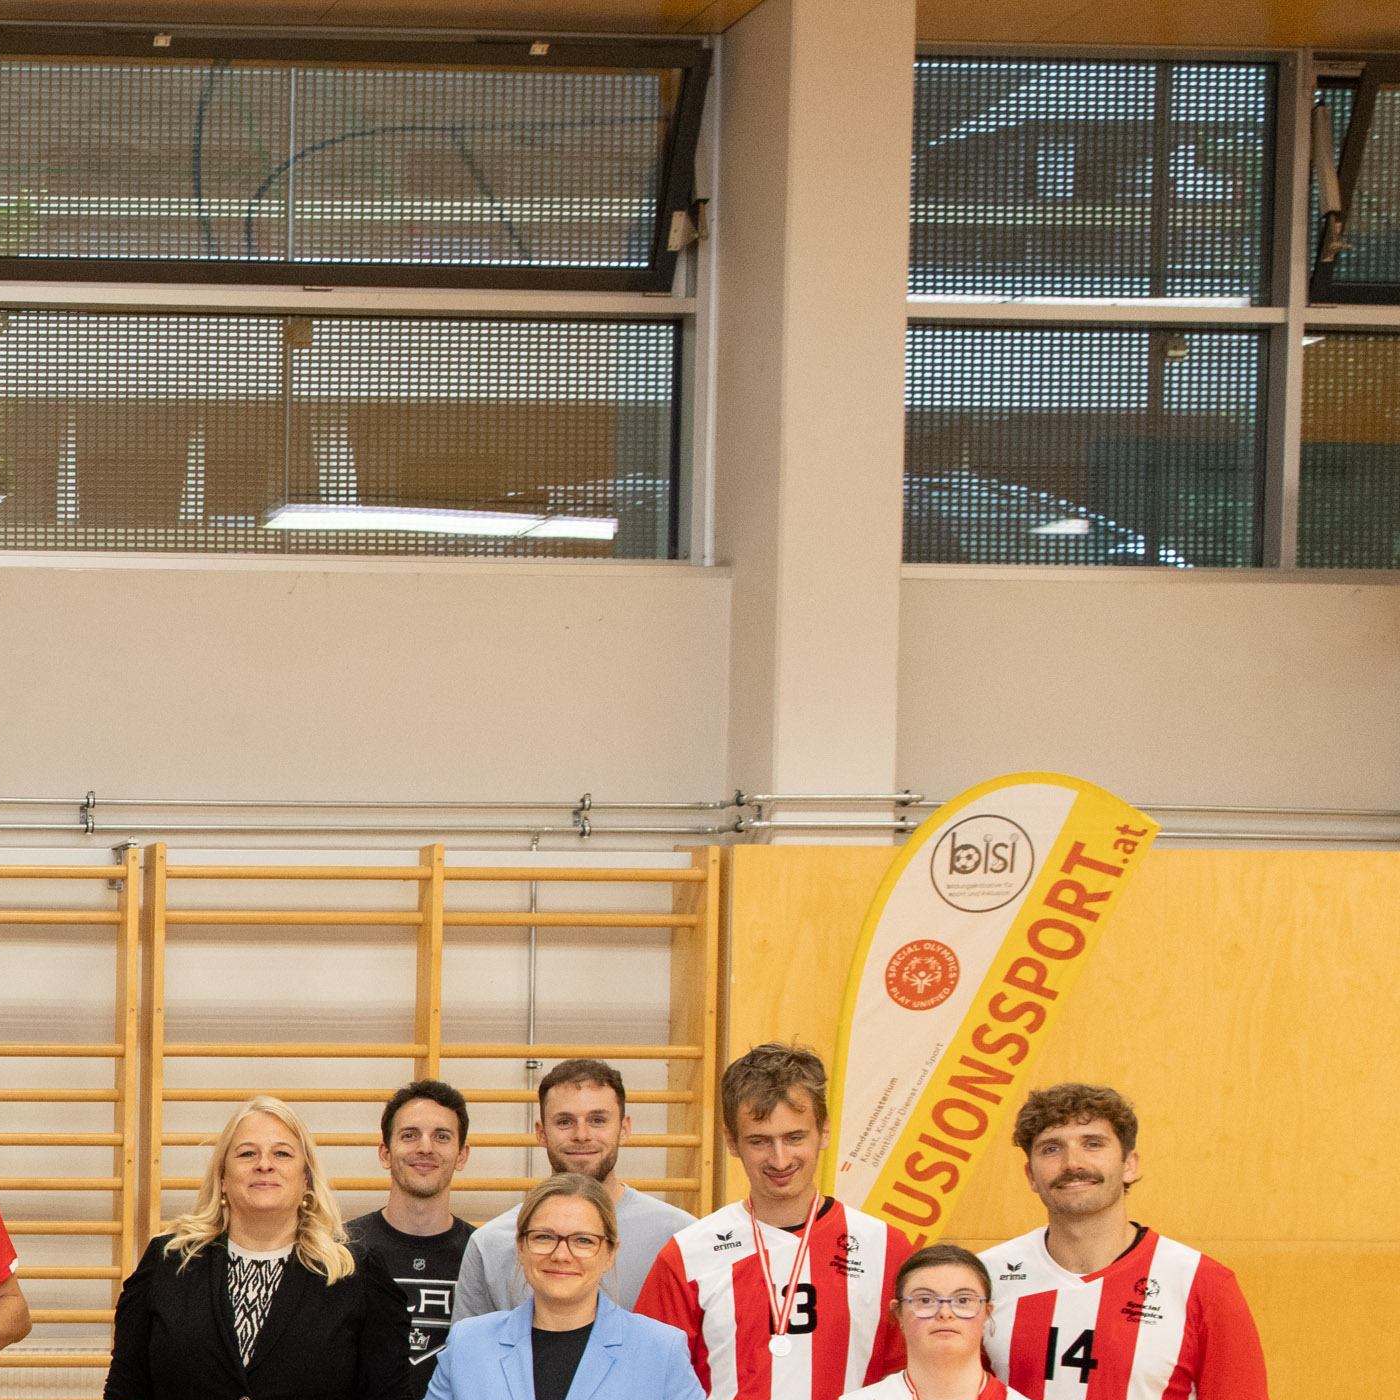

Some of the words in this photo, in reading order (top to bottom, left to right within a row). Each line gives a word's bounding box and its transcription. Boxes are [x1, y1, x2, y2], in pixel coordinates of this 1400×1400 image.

[949, 832, 1020, 875] bisi
[888, 944, 921, 978] SPECIAL
[923, 942, 958, 979] OLYMPICS
[890, 986, 911, 1005] PLAY
[912, 987, 951, 1008] UNIFIED
[882, 824, 1149, 1240] USIONSSPORT.at
[898, 1087, 918, 1116] Dienst
[917, 1068, 929, 1086] und
[925, 1042, 944, 1067] Sport
[849, 1077, 899, 1158] Bundesministerium
[713, 1239, 742, 1252] erima
[999, 1273, 1027, 1281] erima
[1121, 1308, 1164, 1320] Olympics
[1126, 1301, 1161, 1312] Special
[1045, 1326, 1098, 1384] 14
